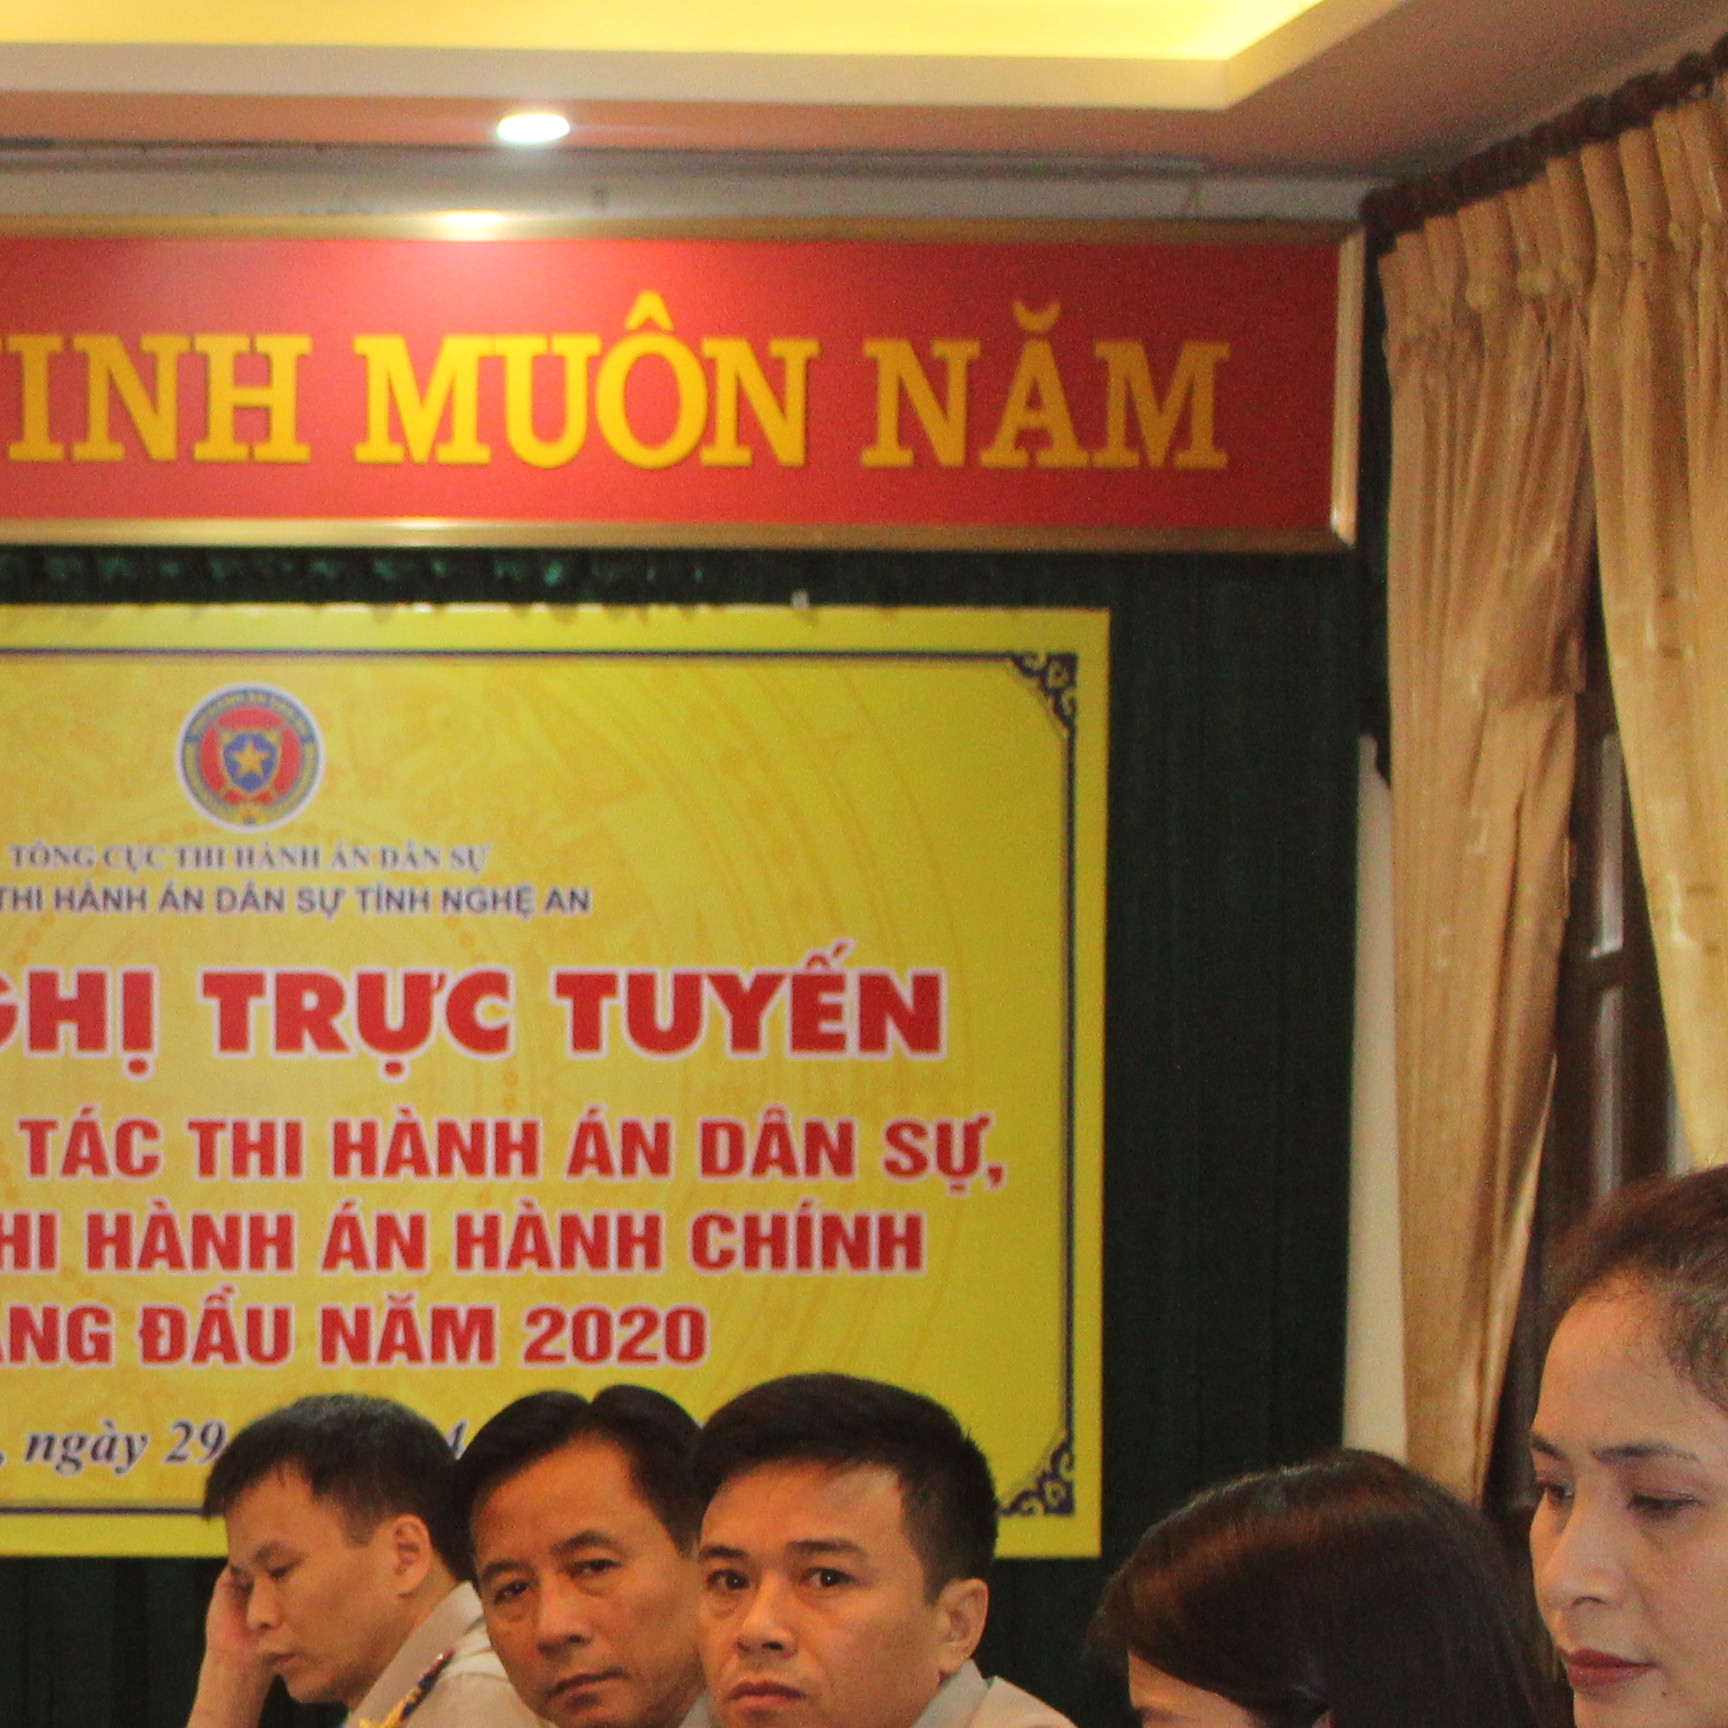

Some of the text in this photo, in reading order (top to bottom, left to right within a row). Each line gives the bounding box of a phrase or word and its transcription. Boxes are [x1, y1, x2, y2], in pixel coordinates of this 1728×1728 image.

[352, 291, 820, 469] MUÔN
[861, 300, 1229, 468] NĂM
[175, 845, 228, 870] THI
[53, 879, 148, 914] HÀNH
[159, 880, 207, 914] ÁN
[215, 880, 286, 914] DÂN
[296, 886, 344, 921] SỰ
[544, 887, 590, 914] AN
[201, 966, 508, 1073] TRỰC
[554, 940, 943, 1055] TUYẾN
[17, 1107, 160, 1177] TÁC
[186, 1119, 303, 1176] THI
[331, 1108, 538, 1176] HÀNH
[566, 1108, 671, 1176] ÁN
[699, 1107, 854, 1176] DÂN
[882, 1113, 1003, 1190] SỰ,
[86, 1202, 295, 1270] HÀNH
[320, 1202, 427, 1270] ÁN
[454, 1202, 663, 1270] HÀNH
[689, 1200, 922, 1271] CHÍNH
[319, 1292, 496, 1362] NĂM
[522, 1305, 707, 1362] 2020
[23, 1418, 150, 1478] ngày
[162, 1419, 228, 1465] 29
